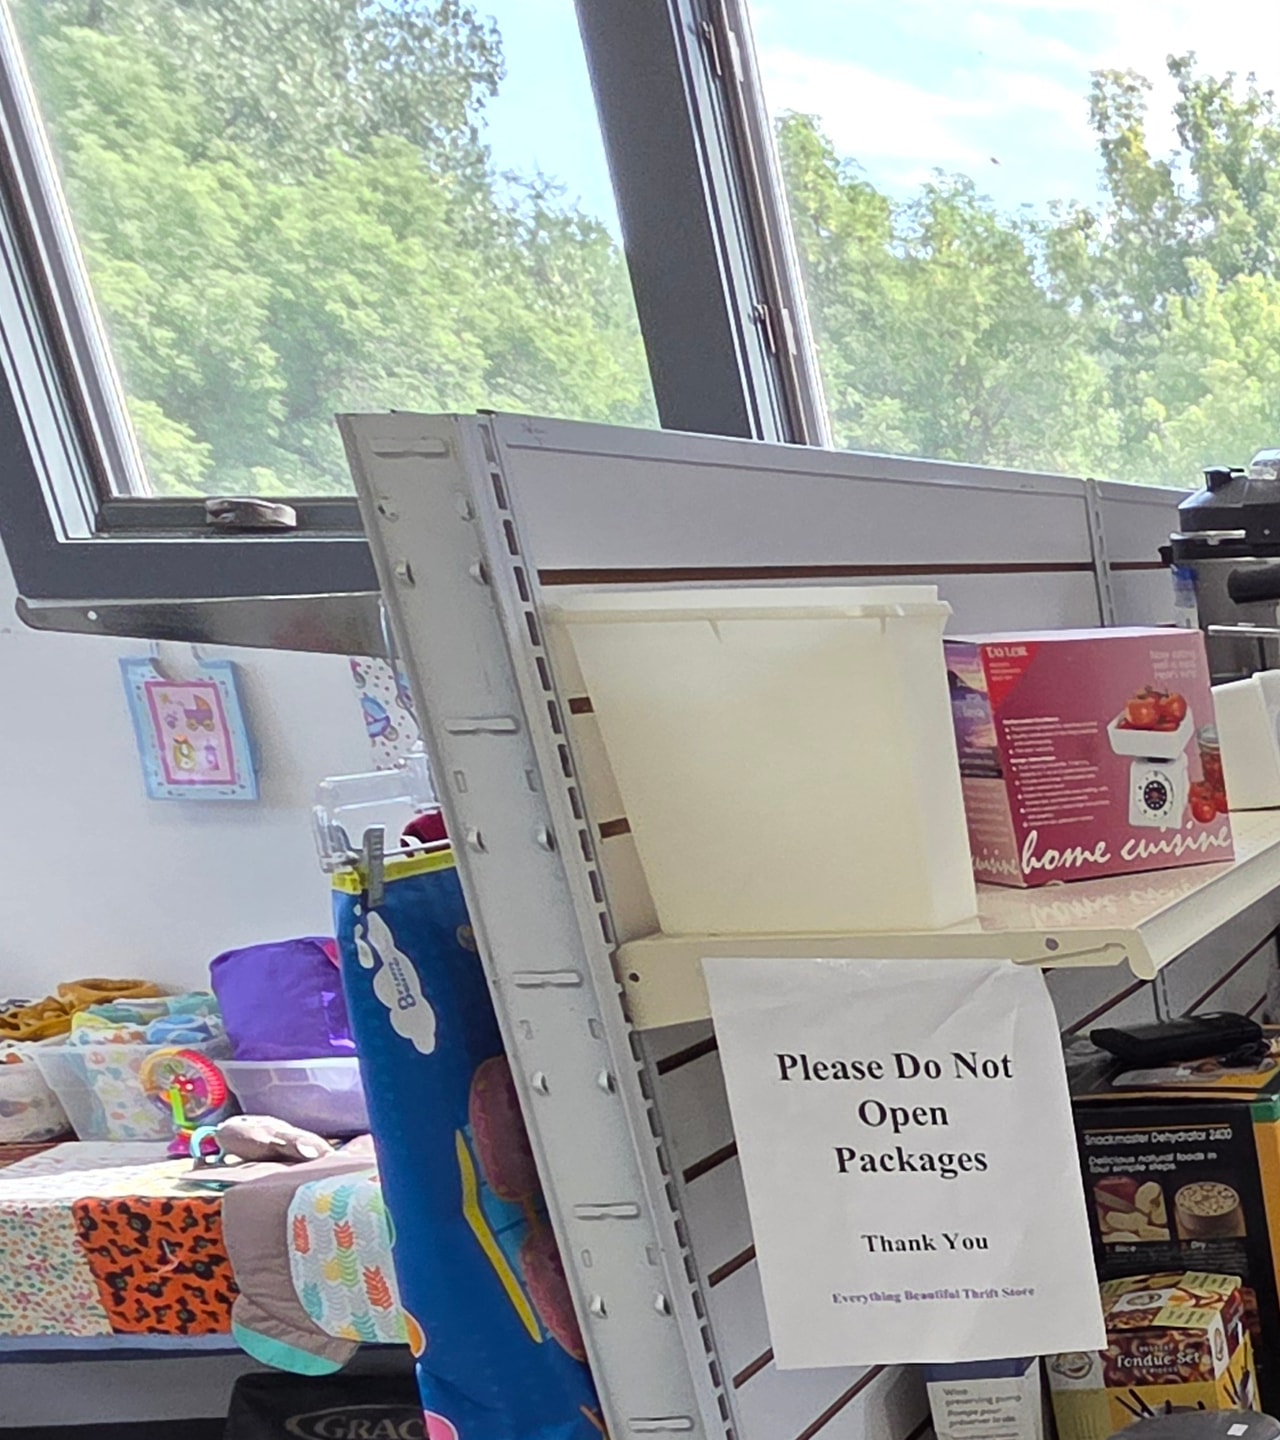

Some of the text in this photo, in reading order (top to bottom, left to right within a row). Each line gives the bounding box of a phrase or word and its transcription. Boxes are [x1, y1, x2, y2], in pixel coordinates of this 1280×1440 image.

[1021, 820, 1233, 875] home cuisine
[775, 1051, 1013, 1082] Please Do Not
[858, 1099, 949, 1133] Open
[1151, 1130, 1206, 1144] Dehydrator
[835, 1146, 988, 1180] Packages
[861, 1232, 989, 1253] Thank You
[832, 1286, 1035, 1305] Everything Beautiful Thrift Store
[1117, 1351, 1201, 1369] Fondue Set
[313, 1414, 425, 1440] GRAC
